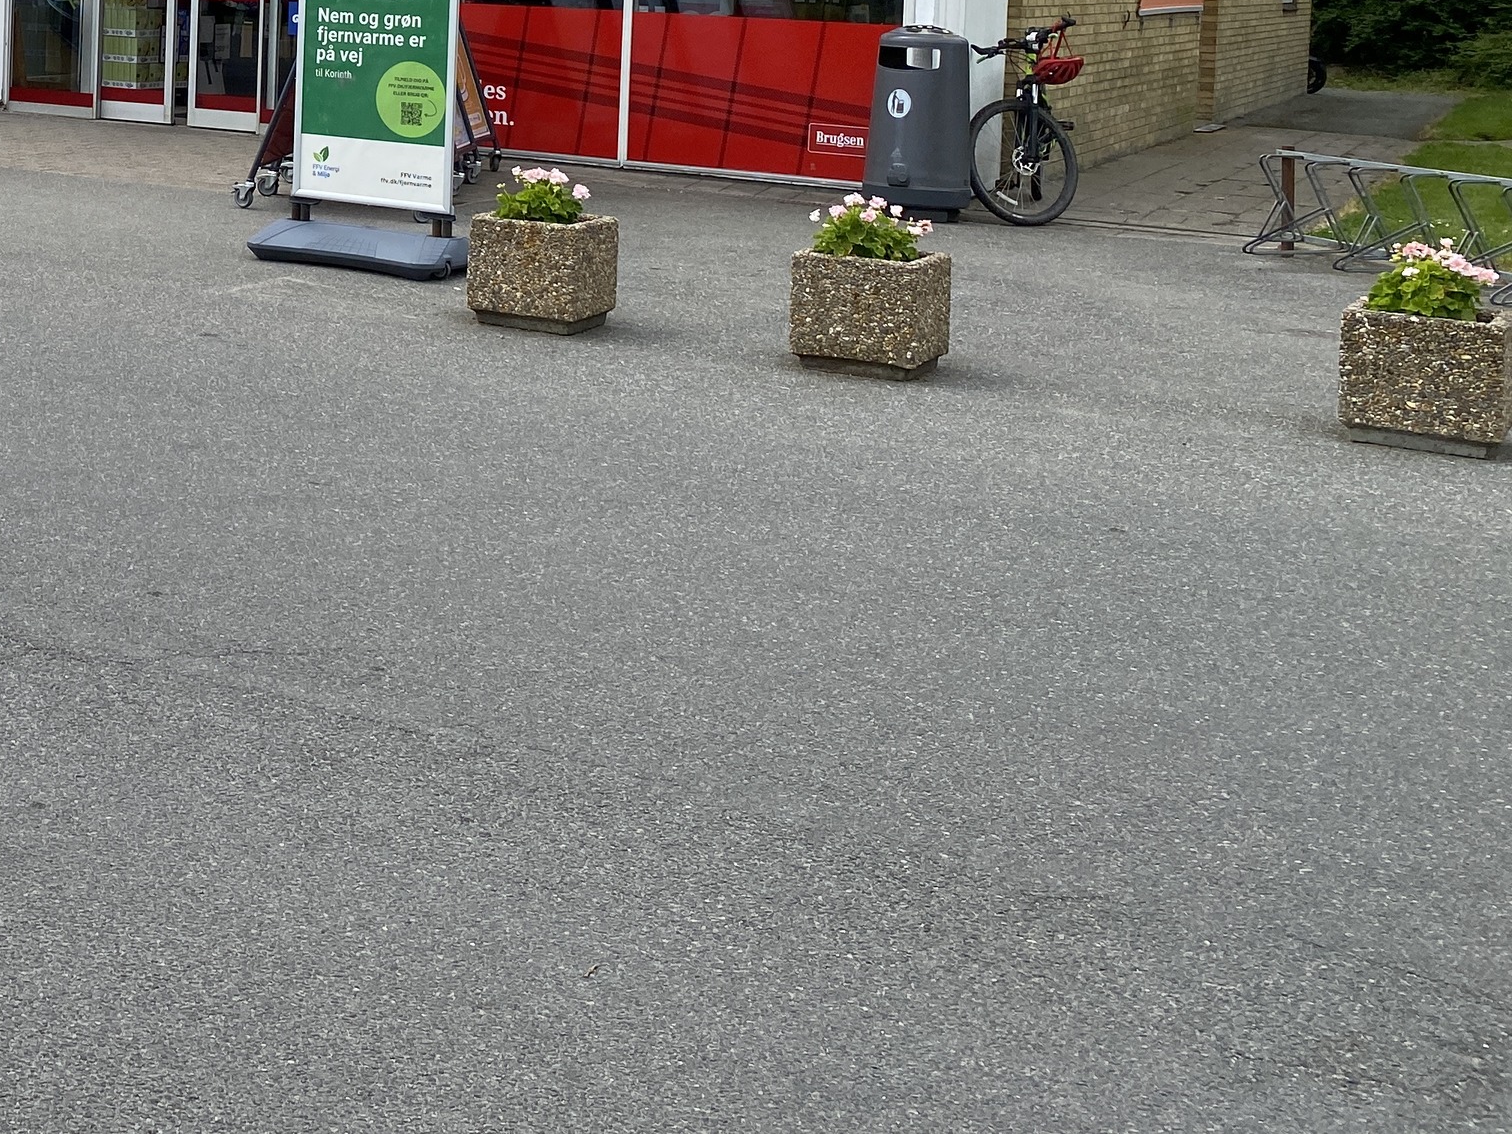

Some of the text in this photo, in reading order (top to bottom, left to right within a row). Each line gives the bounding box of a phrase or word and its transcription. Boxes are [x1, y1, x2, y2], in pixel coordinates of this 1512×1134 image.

[318, 7, 421, 30] Nem og grøn
[317, 26, 426, 48] fjernvarme er
[316, 45, 363, 67] på vej
[315, 68, 353, 79] til Korinth
[816, 131, 864, 147] Brugsen
